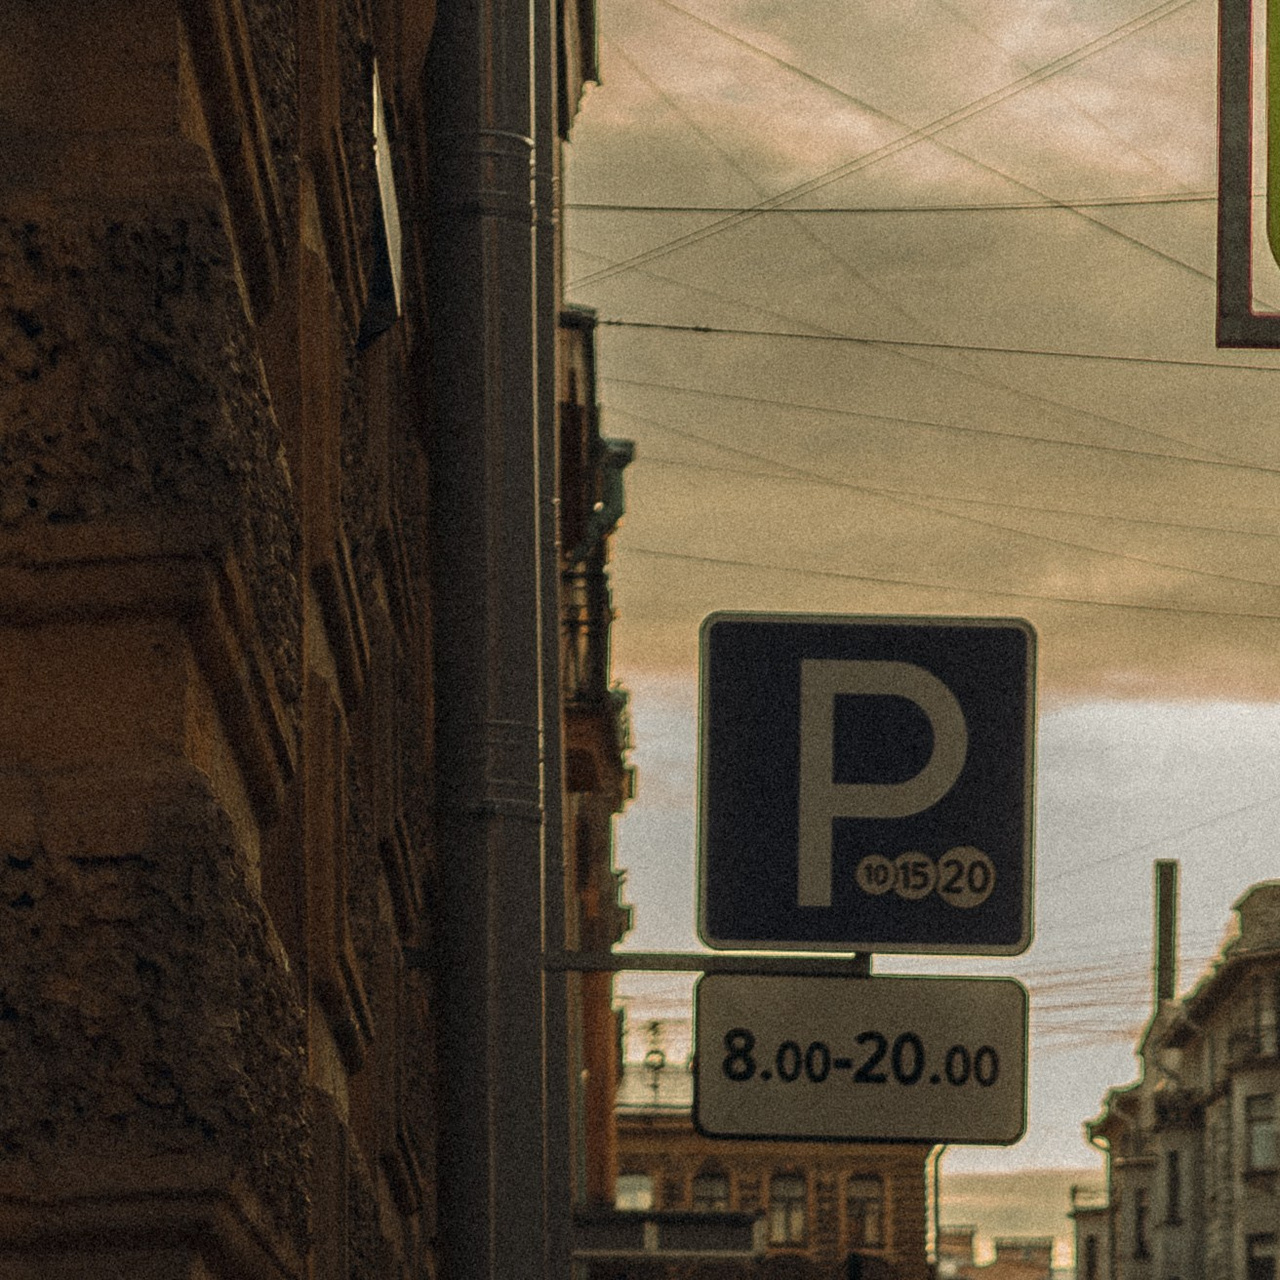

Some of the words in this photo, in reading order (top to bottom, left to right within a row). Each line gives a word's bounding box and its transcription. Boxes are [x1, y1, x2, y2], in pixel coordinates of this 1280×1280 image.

[798, 658, 968, 907] P
[864, 863, 889, 886] 10
[901, 861, 929, 890] 15
[943, 859, 991, 894] 20
[721, 1028, 999, 1088] 8.00-20.00
